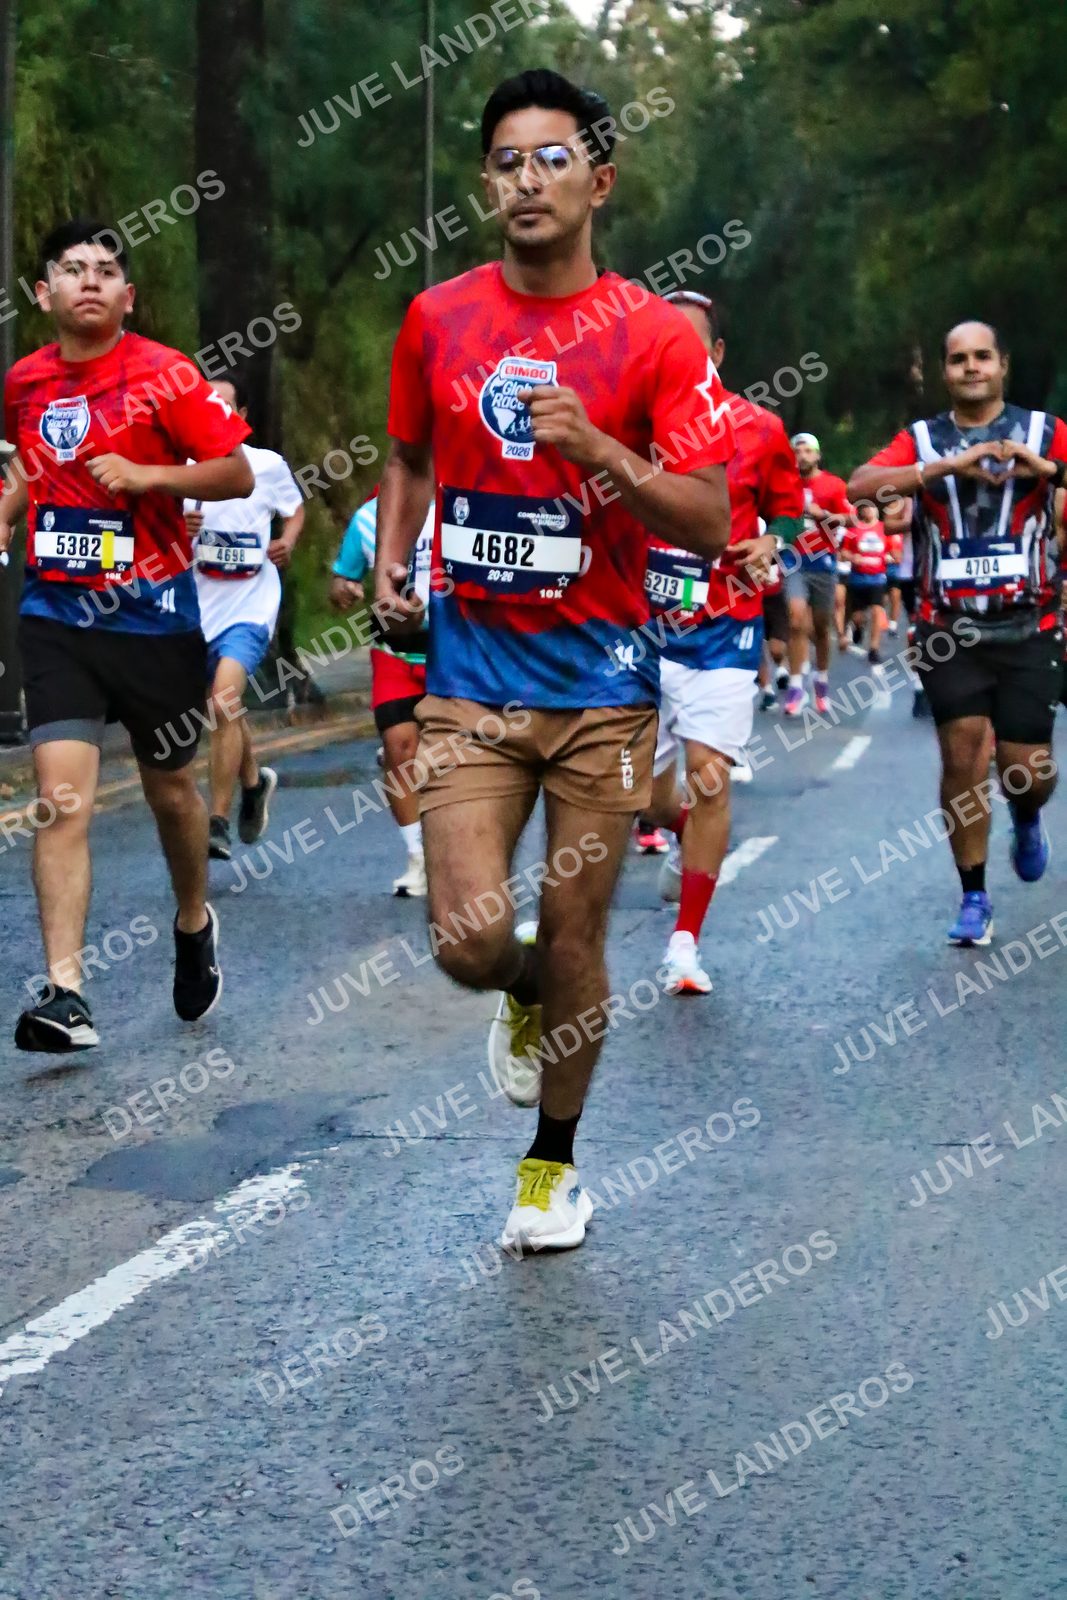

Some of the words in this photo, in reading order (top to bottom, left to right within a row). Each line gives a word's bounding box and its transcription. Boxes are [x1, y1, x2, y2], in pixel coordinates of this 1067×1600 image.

[505, 366, 547, 379] BIMBO
[492, 393, 524, 411] Race
[505, 445, 530, 457] 2026
[56, 535, 101, 557] 5382
[472, 532, 535, 567] 4682
[216, 549, 246, 563] 4698
[965, 557, 999, 575] 4704
[645, 569, 679, 597] 5213
[539, 589, 563, 599] 10K
